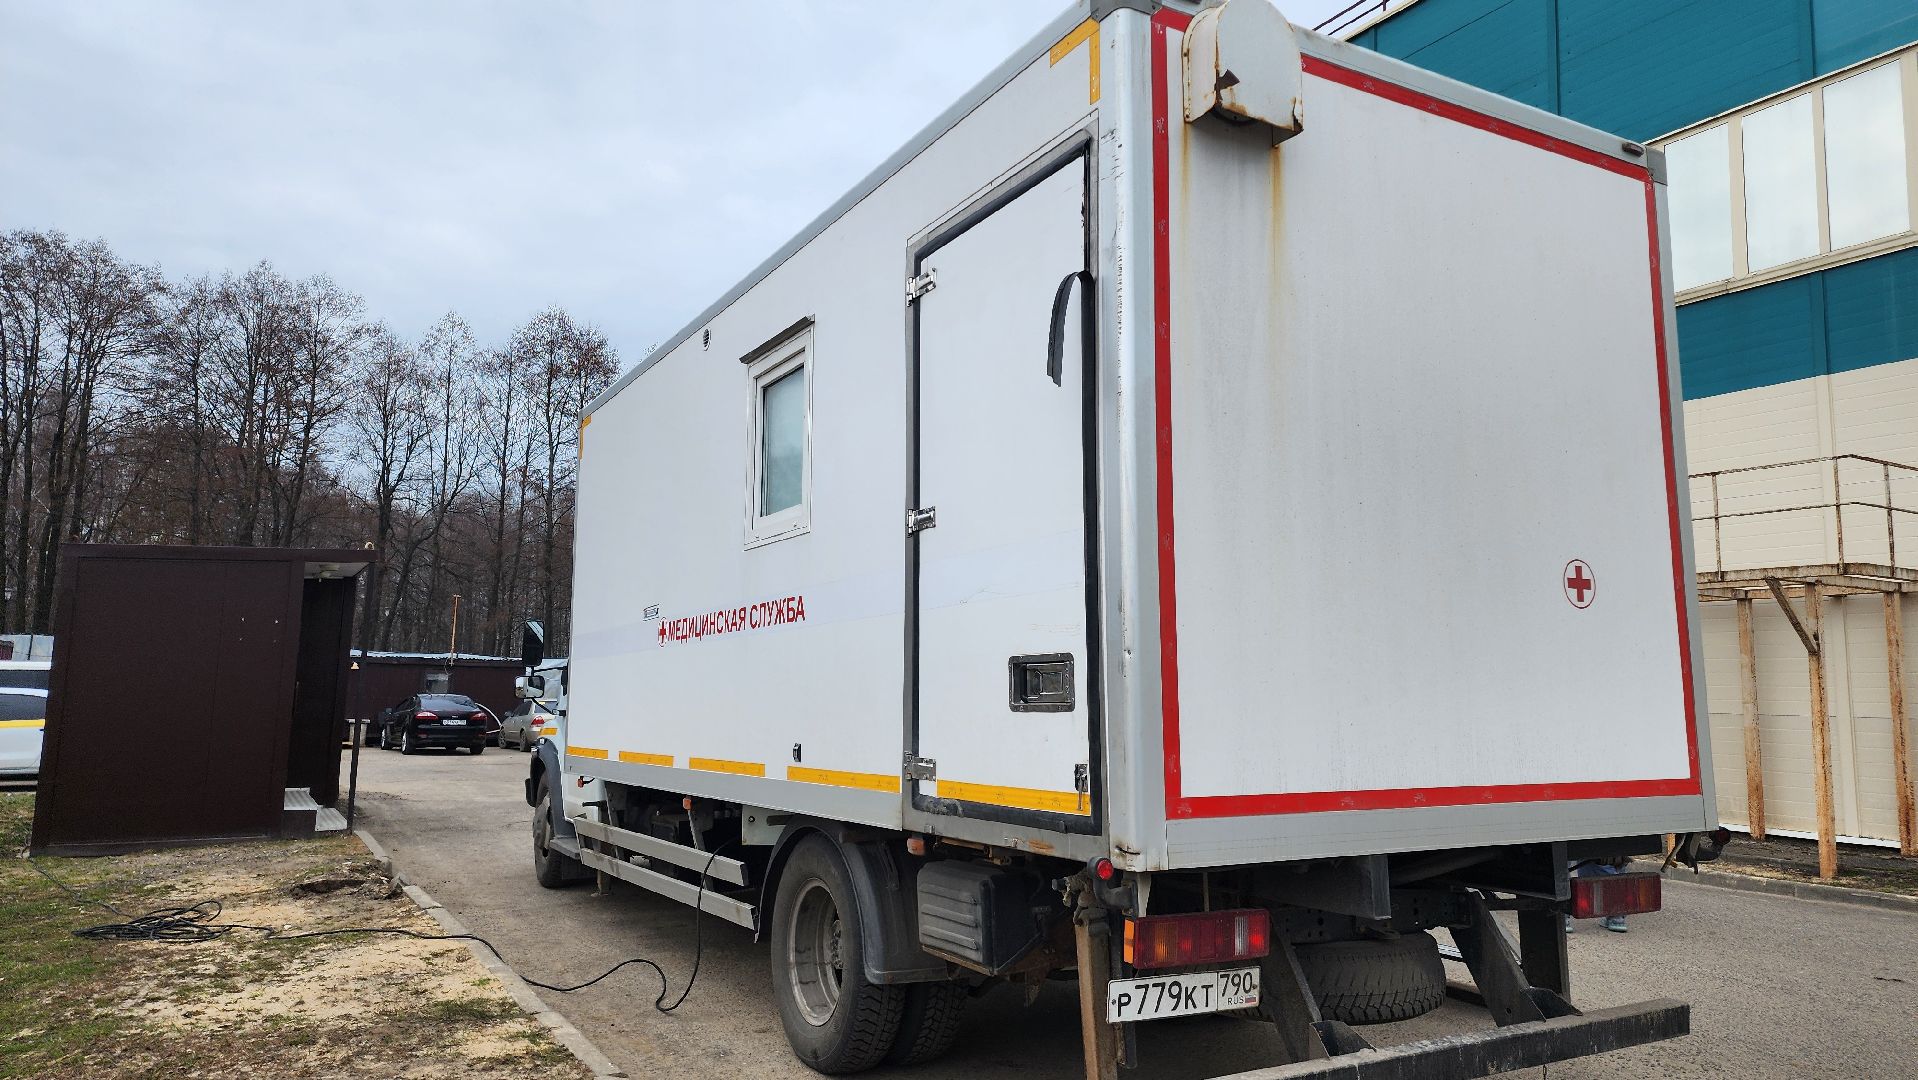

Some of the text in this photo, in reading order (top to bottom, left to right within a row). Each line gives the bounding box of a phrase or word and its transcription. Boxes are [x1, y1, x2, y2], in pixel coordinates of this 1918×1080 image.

[668, 607, 746, 643] МЕДИЦИНСКАЯ
[750, 595, 805, 629] СЛУЖБА
[1117, 972, 1253, 1017] Р779КТ 790
[1227, 995, 1244, 1006] RUS
